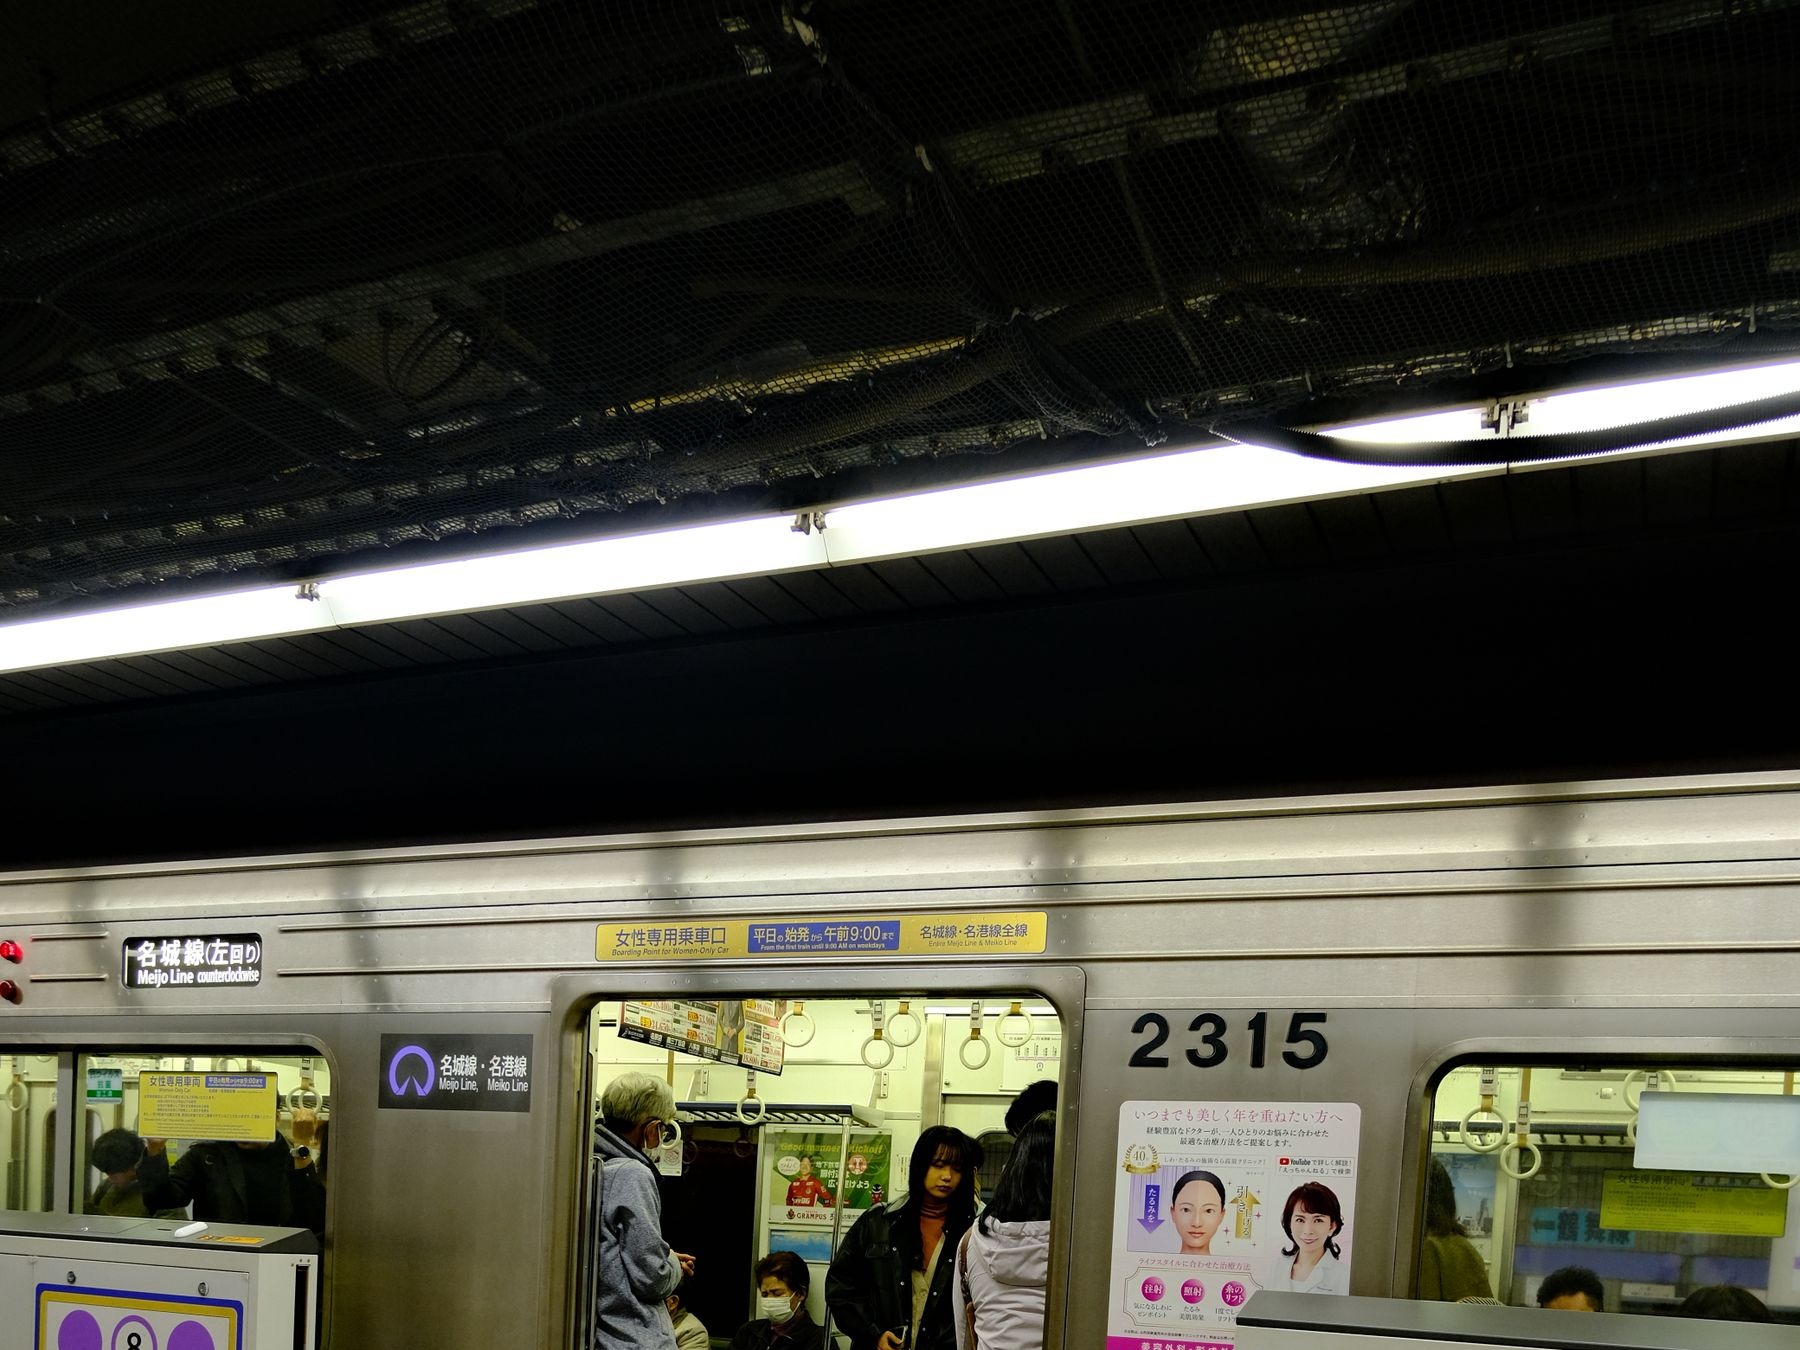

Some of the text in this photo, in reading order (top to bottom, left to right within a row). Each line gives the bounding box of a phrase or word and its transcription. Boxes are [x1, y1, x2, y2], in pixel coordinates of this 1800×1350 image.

[616, 927, 726, 947] 女性専用乗車口
[753, 925, 895, 943] 平日の始発から午前9:00まで
[920, 924, 1028, 939] 名城線・名港線全線
[137, 938, 261, 967] 名城線(左回り)
[612, 948, 641, 957] Boarding
[662, 947, 671, 955] for
[673, 947, 715, 956] Women-Only
[137, 967, 259, 988] Meijo Line counterclockwise
[1128, 1011, 1329, 1070] 2315
[440, 1055, 527, 1077] 名城線・名港線
[150, 1076, 200, 1087] 女性専用車両
[439, 1078, 479, 1093] Meijo Line,
[488, 1078, 529, 1092] Meiko Line
[1135, 1108, 1343, 1123] いつまでも美しく年を重ねたい方へ
[1146, 1126, 1329, 1138] 経験豊富なドクターが、一人ひとりのお悩みに合わせた
[1180, 1138, 1292, 1147] 最適な治療方法をご提案します。
[1147, 1188, 1157, 1223] たるみを
[1139, 1258, 1251, 1271] ライフスタイルに合わせた治療方法
[1145, 1284, 1163, 1295] 注射
[1183, 1286, 1202, 1297] 照射
[1225, 1284, 1243, 1293] 糸の
[1225, 1294, 1244, 1303] リフト
[1134, 1303, 1172, 1311] 気になるしわに
